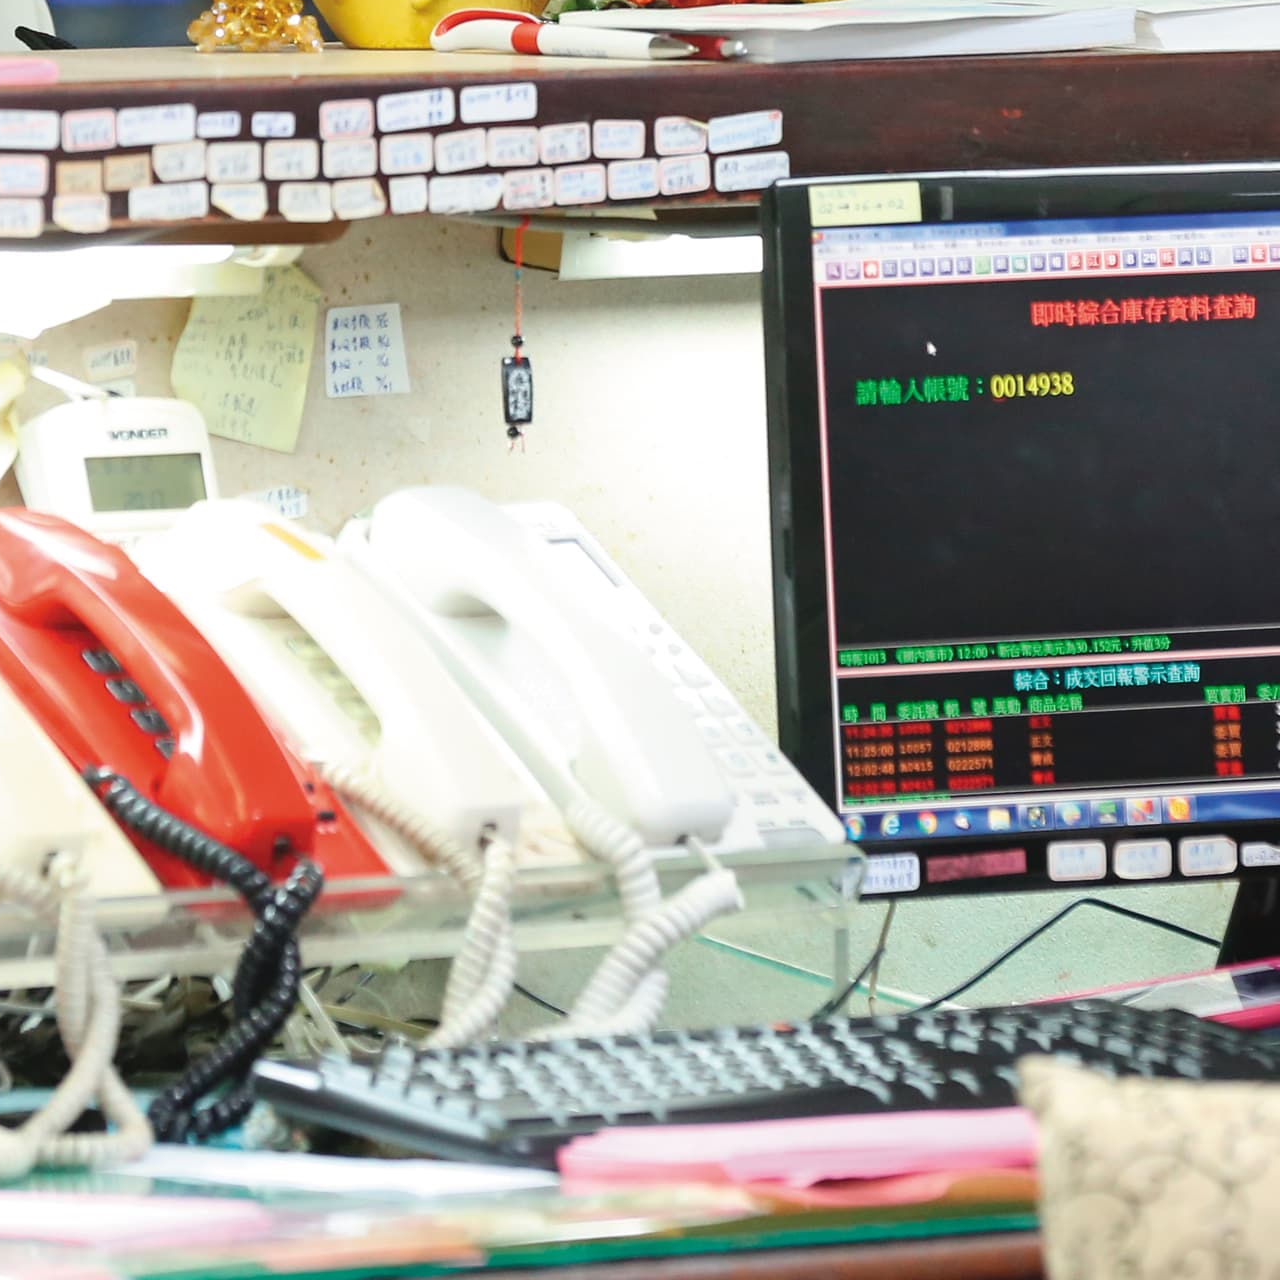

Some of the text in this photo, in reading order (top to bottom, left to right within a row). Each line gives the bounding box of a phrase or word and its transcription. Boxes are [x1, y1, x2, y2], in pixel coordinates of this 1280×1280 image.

[1030, 293, 1256, 327] 即時綜合庫存資料查詢
[990, 371, 1074, 400] 0014938
[1026, 691, 1084, 714] 商品名稱
